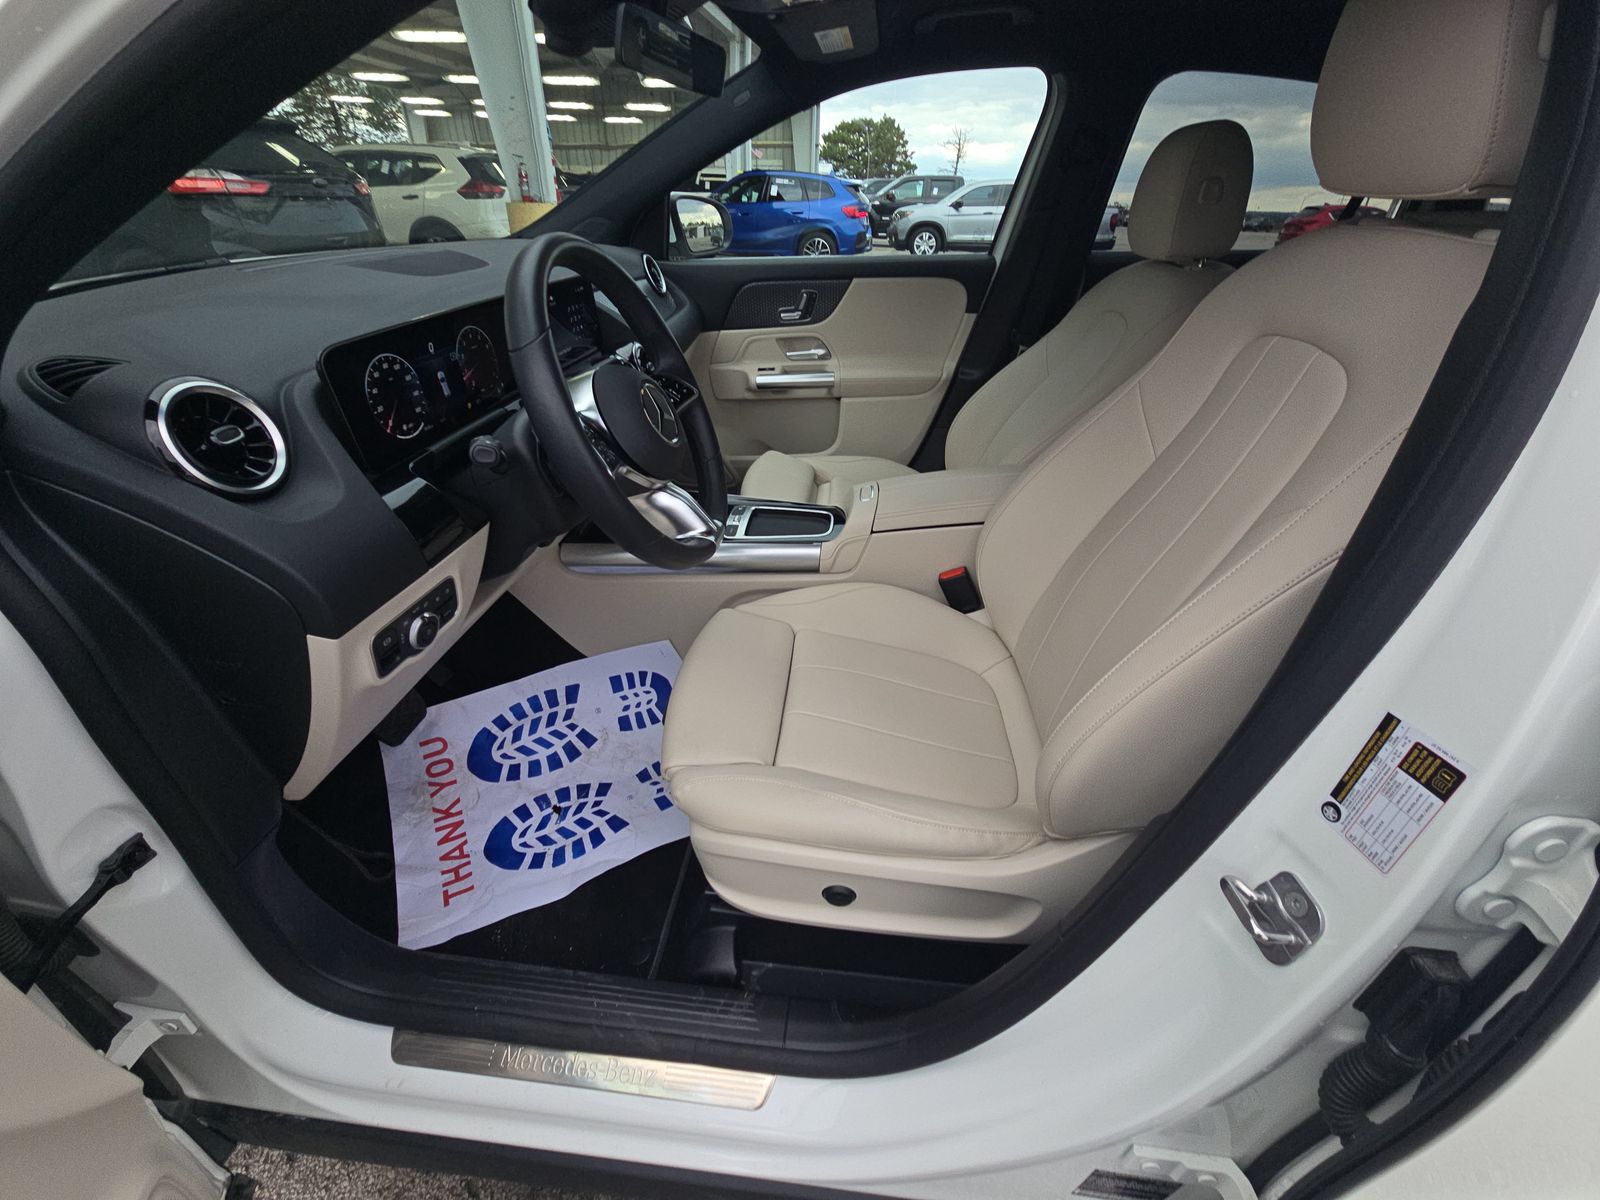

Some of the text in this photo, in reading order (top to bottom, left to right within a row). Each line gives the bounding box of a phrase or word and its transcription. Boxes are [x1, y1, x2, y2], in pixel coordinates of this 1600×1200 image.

[419, 737, 475, 907] THANK YOU
[501, 1043, 657, 1087] Mercedes-Benz
